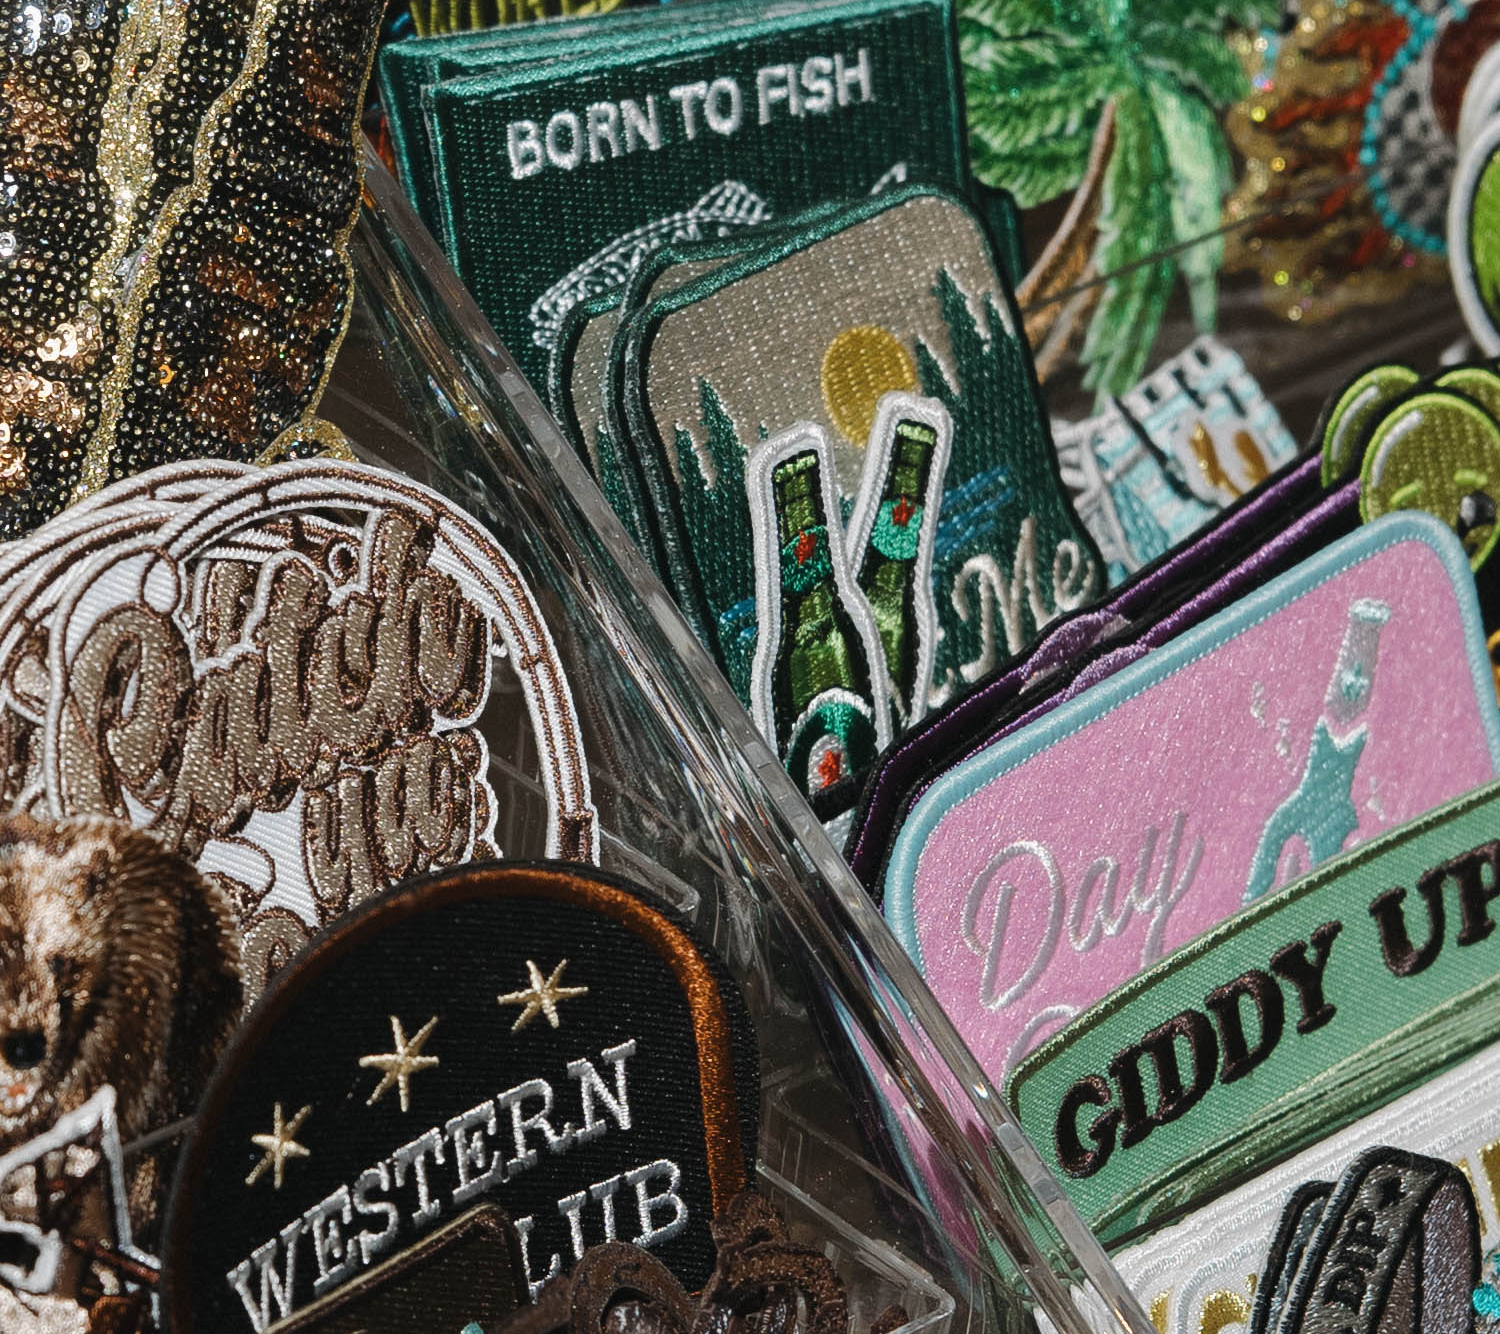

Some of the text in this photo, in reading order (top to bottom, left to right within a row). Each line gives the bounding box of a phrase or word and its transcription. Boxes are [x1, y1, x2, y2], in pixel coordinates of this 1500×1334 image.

[506, 48, 873, 179] BORN TO FISH
[961, 812, 1202, 1012] Day
[1053, 919, 1344, 1180] GIDDY
[226, 1040, 637, 1334] WESTERN
[512, 1158, 690, 1304] LUB
[1324, 1210, 1390, 1317] DIP
